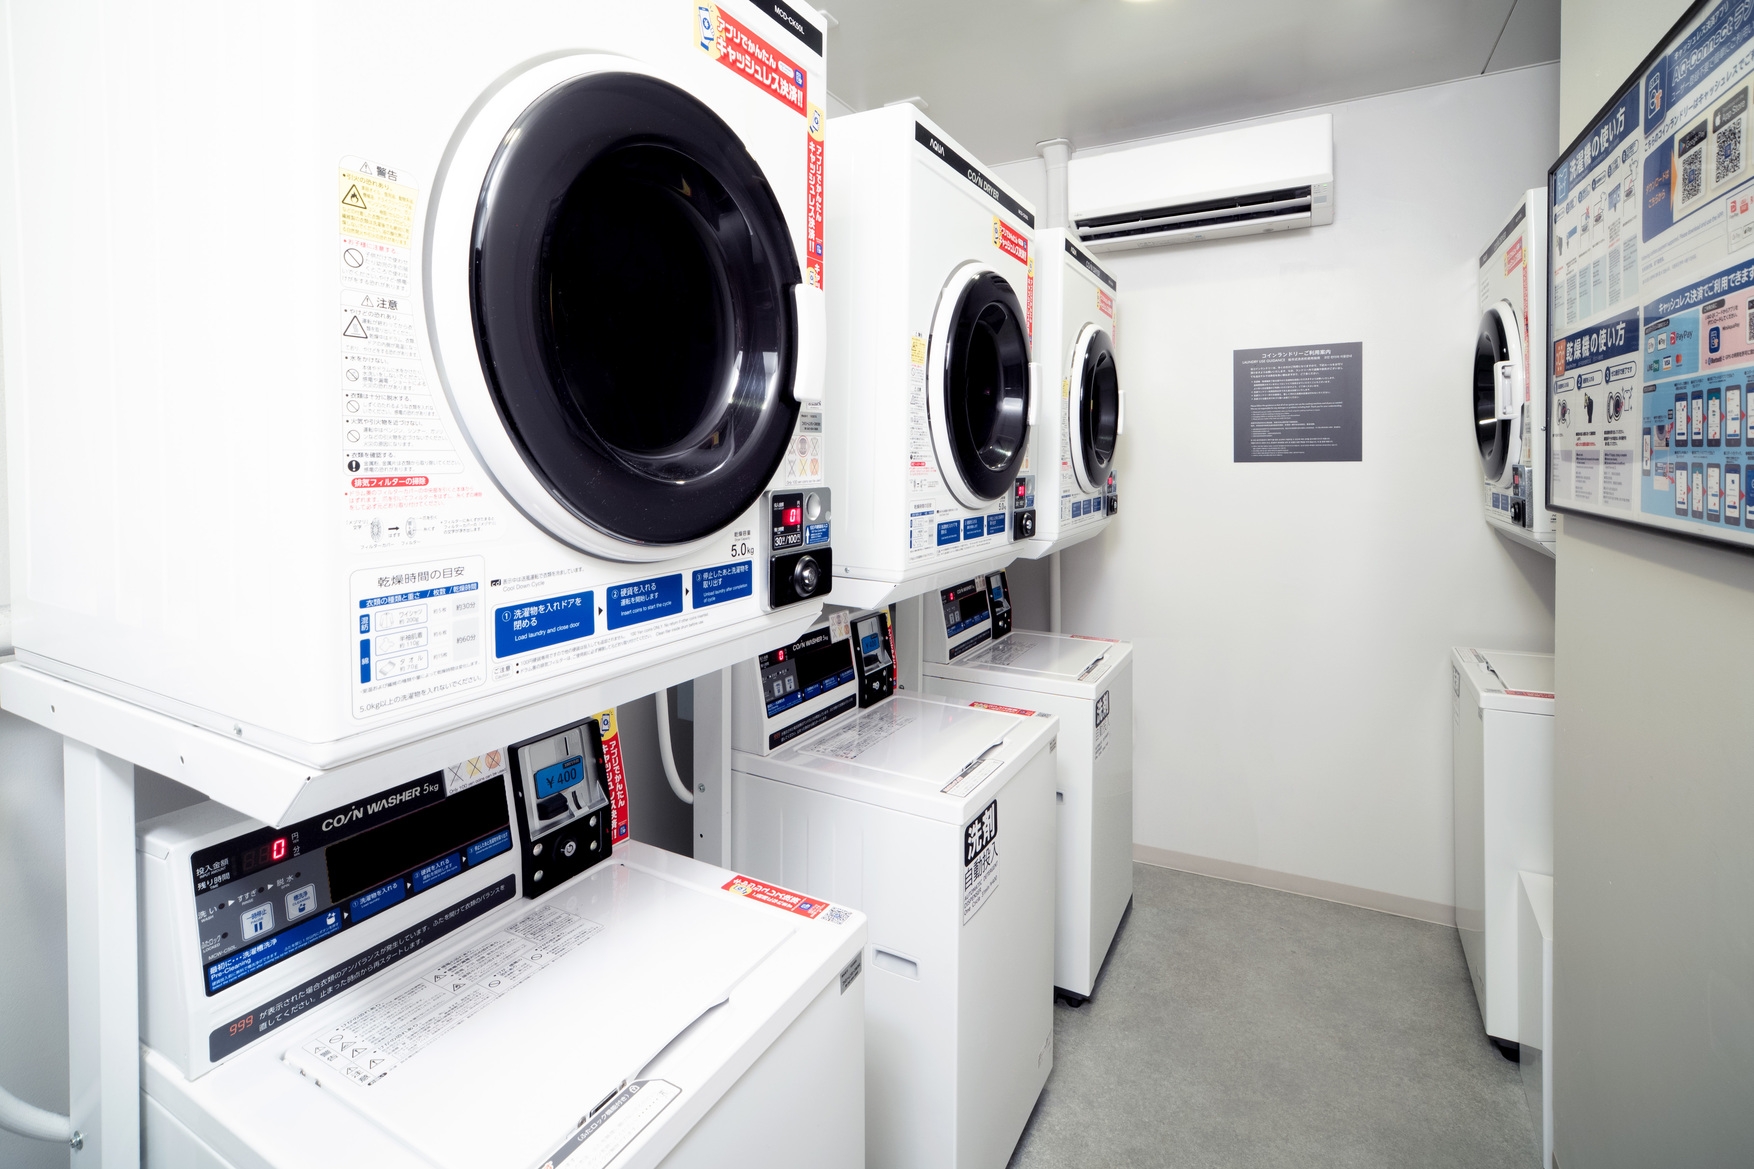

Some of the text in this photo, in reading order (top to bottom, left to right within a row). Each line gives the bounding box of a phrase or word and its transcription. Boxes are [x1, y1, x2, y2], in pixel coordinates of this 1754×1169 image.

[774, 4, 805, 35] MCD-CK50L
[716, 16, 777, 69] アプリでかんたん
[716, 36, 803, 108] キャッシュレス決済!!
[1731, 99, 1746, 115] Store
[929, 138, 945, 157] AQUA
[376, 166, 397, 181] 警告
[982, 181, 1000, 201] DRYER
[376, 297, 398, 310] 注意
[1566, 321, 1626, 363] 乾燥機の使い方
[1676, 331, 1693, 341] PayPay
[1262, 349, 1331, 359] コインランドリーご利用案内
[354, 477, 426, 487] 排気フィルターの掃除
[377, 566, 465, 588] 乾燥時間の目安
[702, 565, 749, 580] 停止したあと洗濯物を
[503, 580, 545, 592] Cool Down Cycle
[620, 582, 657, 598] 硬貨を入れる
[703, 578, 722, 588] 取り出す
[366, 592, 420, 608] 衣類の種類と重さ
[456, 602, 476, 611] 約30分
[620, 593, 659, 606] 運転を開始します
[398, 609, 422, 618] ワイシャツ
[513, 597, 582, 620] 洗濯物を入れドアを
[360, 617, 369, 631] 混紡
[513, 616, 538, 630] 閉める
[515, 621, 580, 641] Load laundry and close door
[456, 634, 476, 644] 約60分
[609, 740, 625, 807] アプリでかんたん
[367, 786, 421, 816] WASHER
[423, 782, 439, 794] 5kg
[291, 832, 299, 840] 円
[968, 803, 995, 860] 洗剤
[273, 838, 285, 860] 0
[293, 845, 300, 853] 分
[196, 858, 229, 876] 投入金額
[420, 858, 450, 876] 硬貨を入れる
[964, 841, 998, 892] 自動投入
[197, 872, 230, 890] 残り時間
[237, 889, 257, 902] すすぎ
[292, 896, 310, 906] CLEANING
[293, 892, 308, 902] 槽洗浄
[359, 882, 398, 905] 洗濯物を入れる
[247, 908, 267, 920] 一時停止
[250, 917, 264, 925] PAUSE
[202, 934, 221, 949] ふたロック
[203, 943, 221, 953] LOCKED
[208, 944, 237, 960] MCW-C50L
[211, 958, 252, 980] Pre-Cleaning
[258, 937, 425, 1033] 直してください。止まった時点から再スタートします。
[229, 1014, 254, 1038] 999
